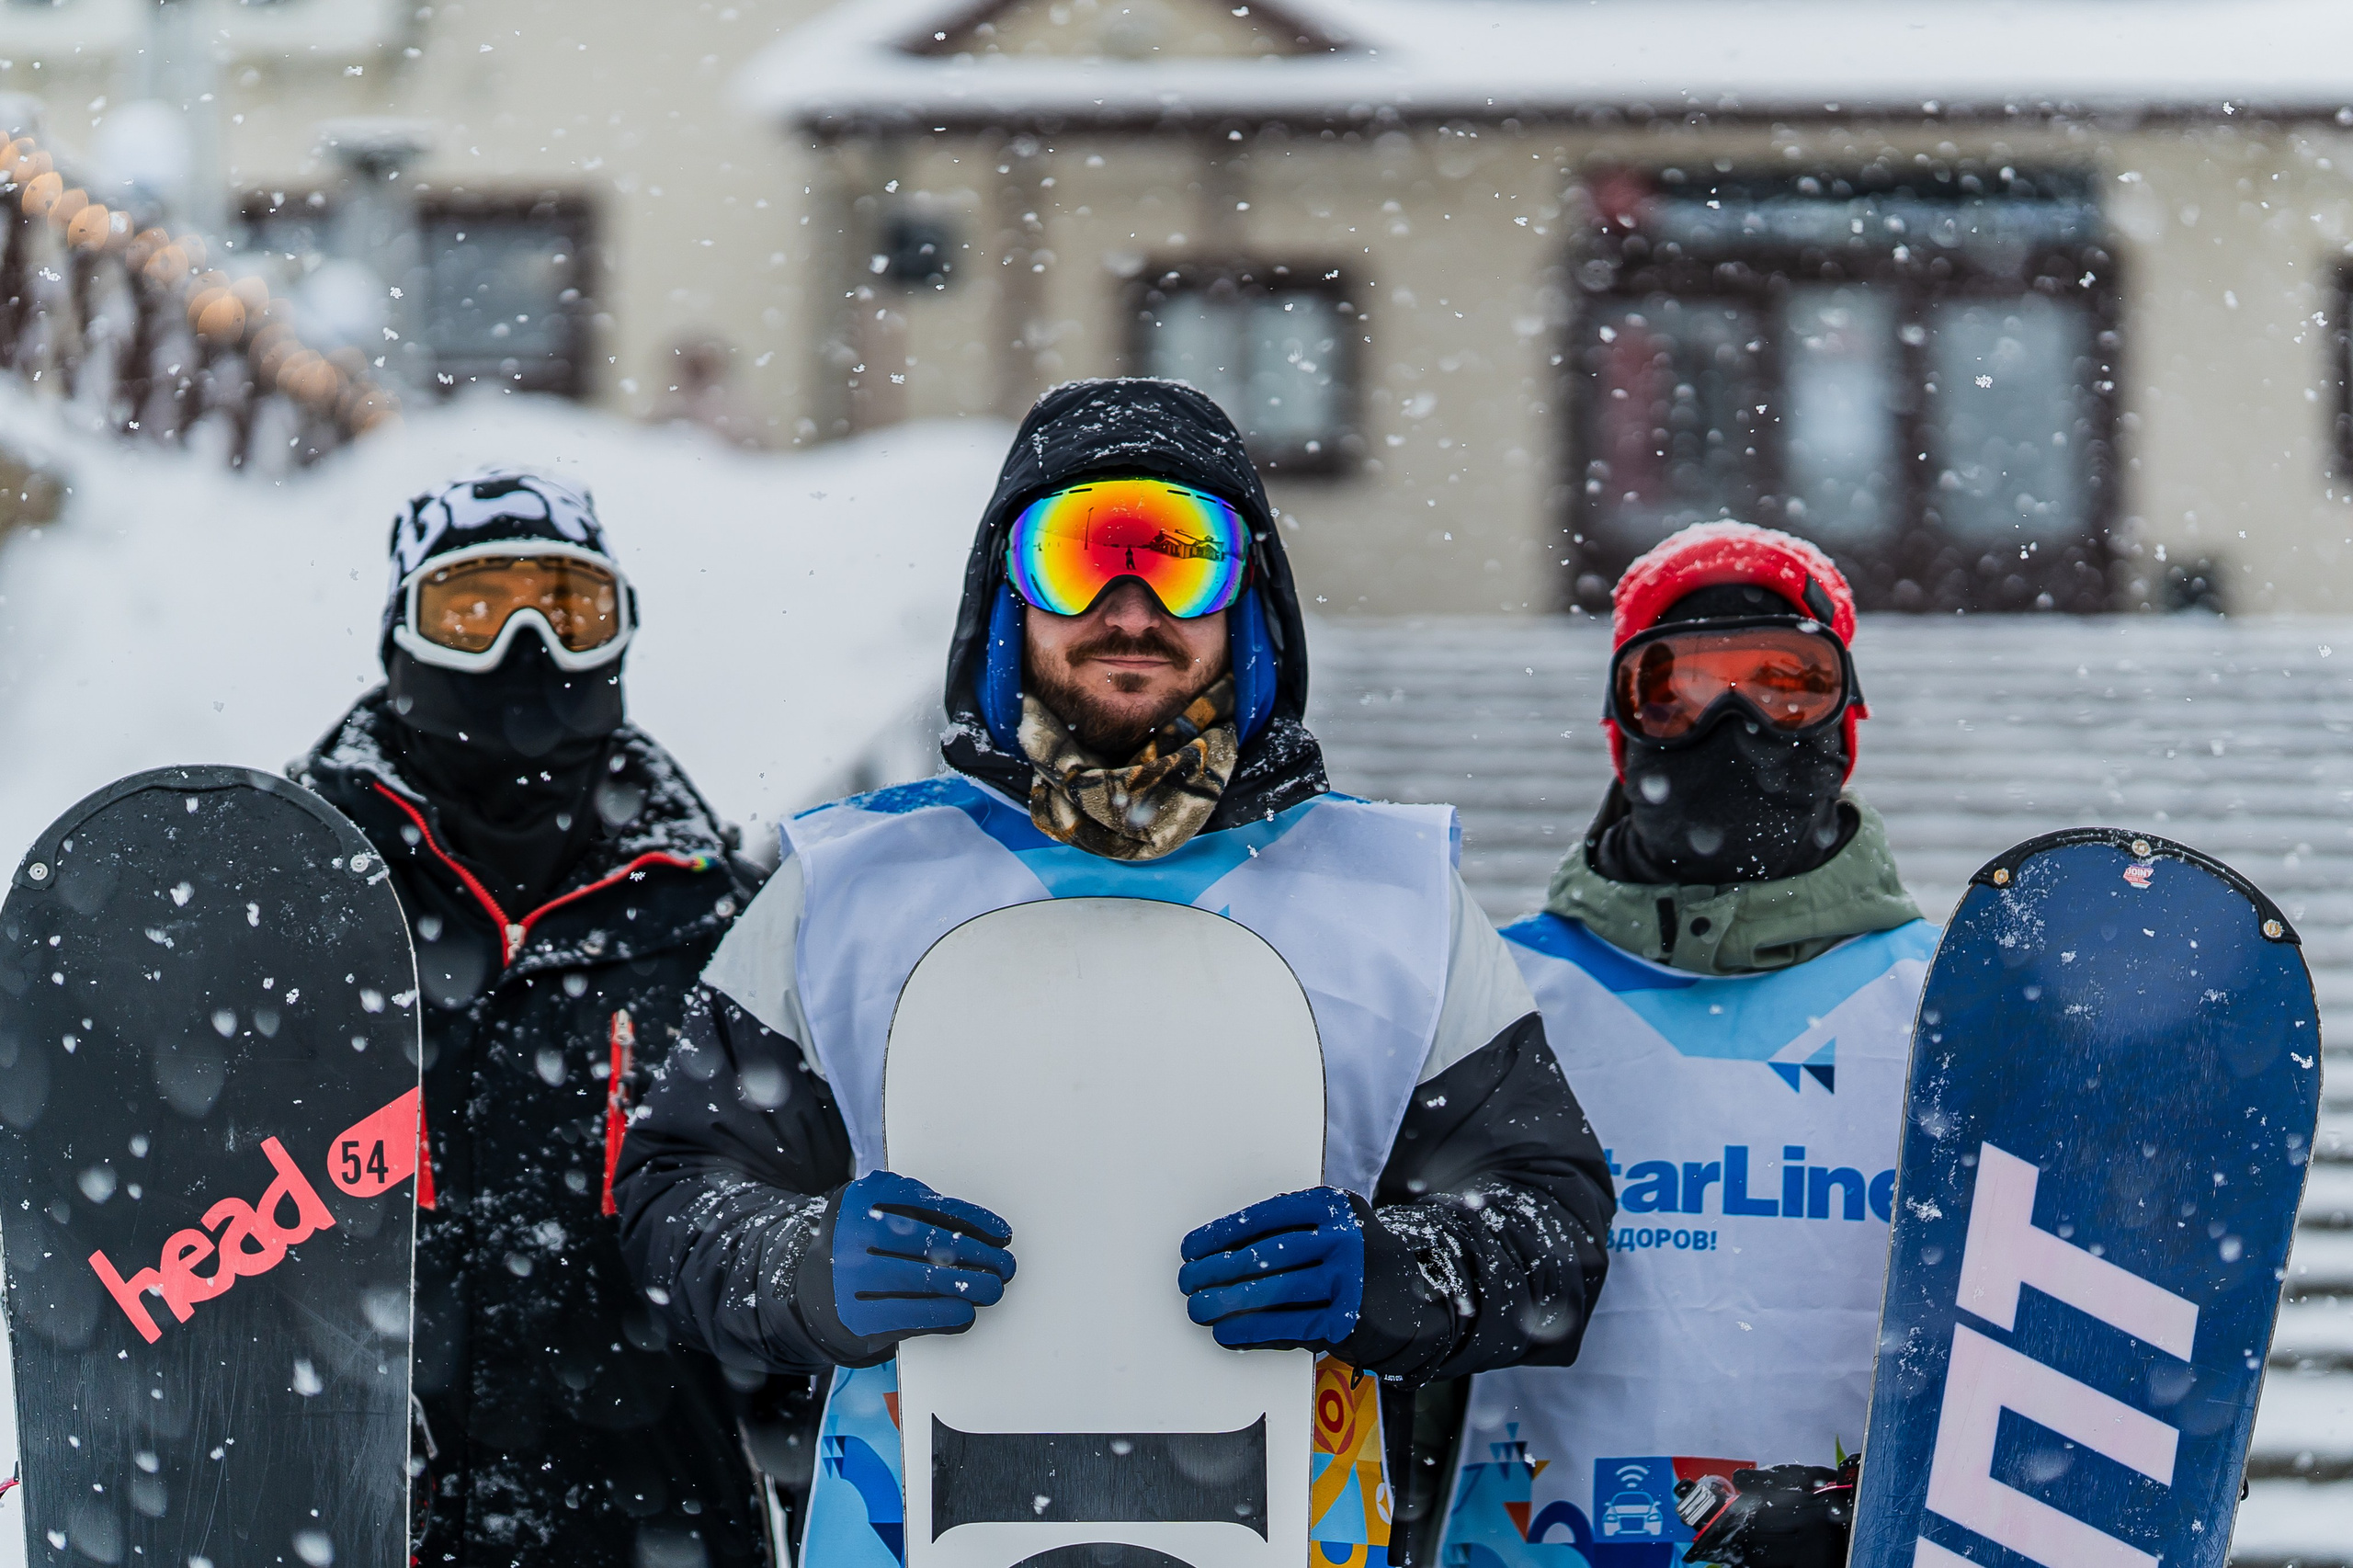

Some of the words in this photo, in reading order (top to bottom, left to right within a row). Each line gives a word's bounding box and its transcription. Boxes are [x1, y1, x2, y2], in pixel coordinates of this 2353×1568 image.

[2126, 867, 2154, 878] JOINT
[342, 1140, 389, 1185] 54
[88, 1136, 335, 1344] head
